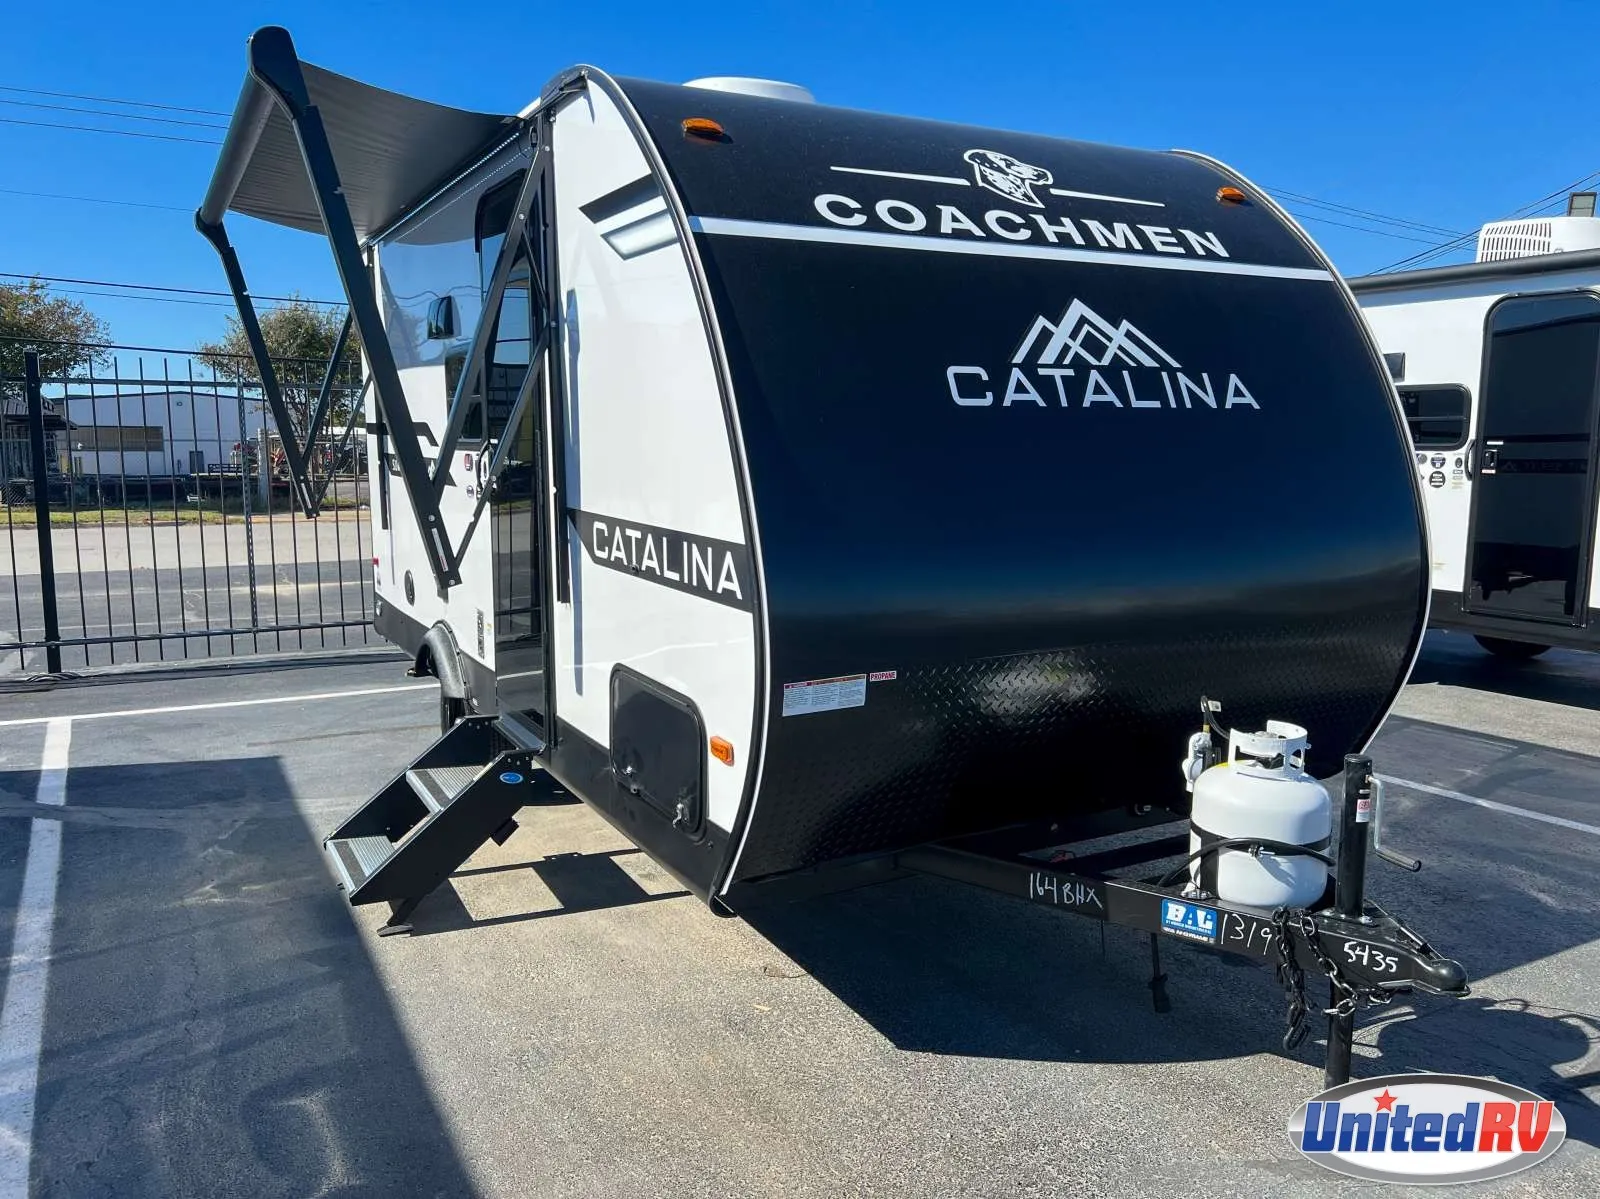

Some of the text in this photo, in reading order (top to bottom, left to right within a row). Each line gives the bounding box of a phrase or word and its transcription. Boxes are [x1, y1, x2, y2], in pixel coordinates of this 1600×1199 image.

[814, 193, 1229, 258] COACHMEN
[946, 365, 1261, 409] CATALINA
[593, 521, 742, 600] CATALINA
[870, 671, 896, 681] PROPANE
[1166, 902, 1213, 930] BAL
[1220, 913, 1273, 956] 1319
[1343, 941, 1399, 973] 5435
